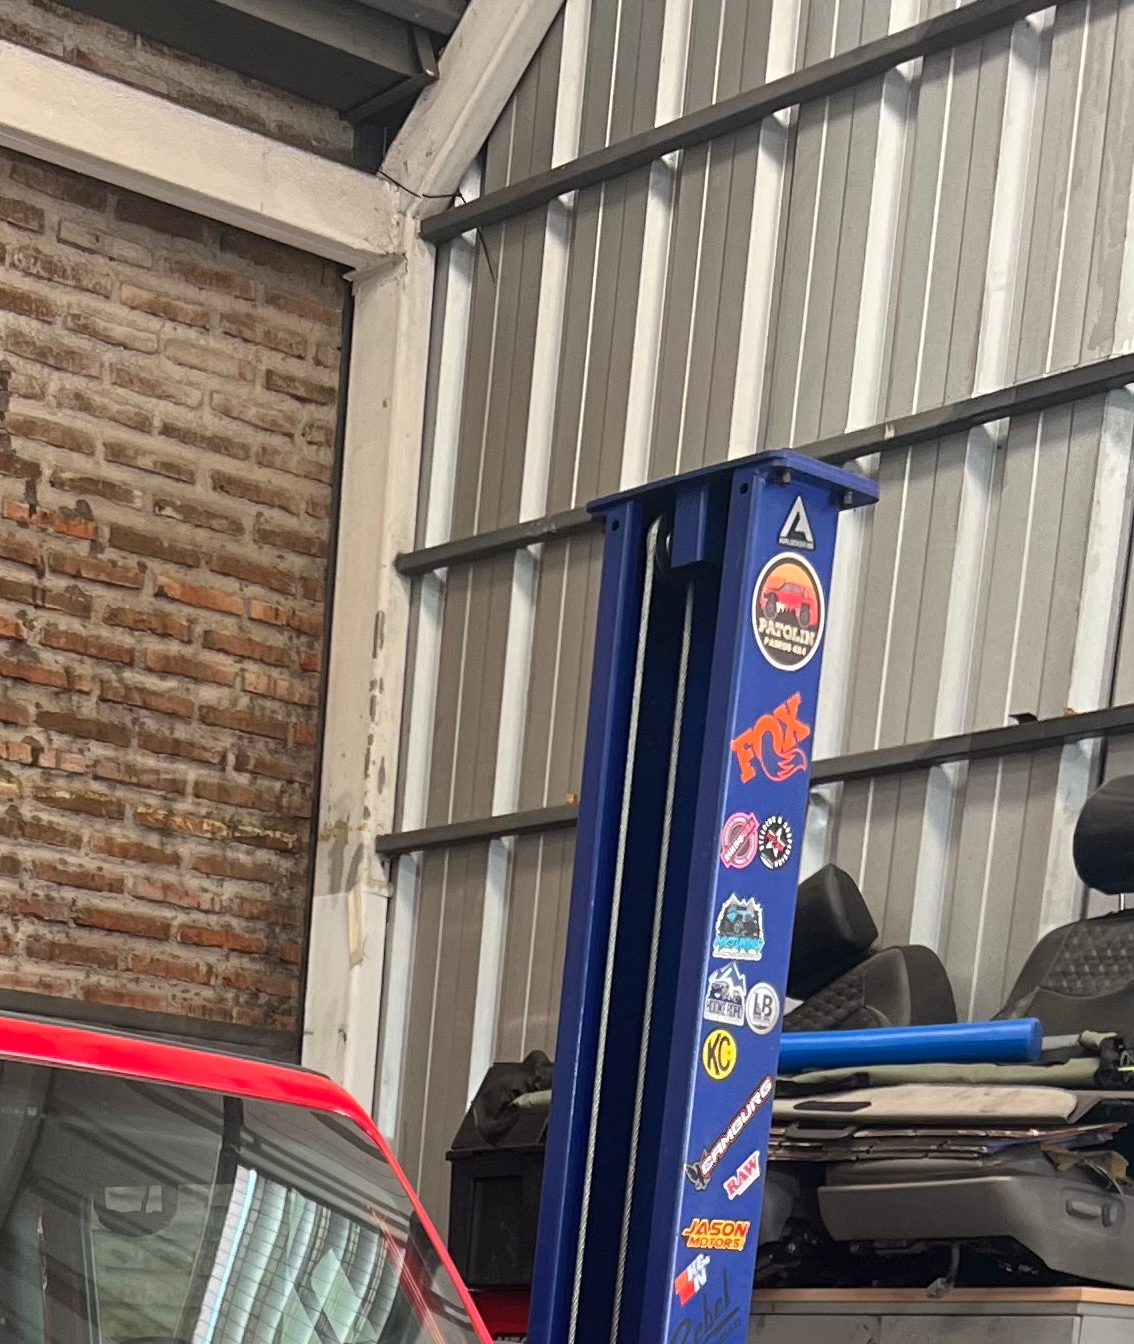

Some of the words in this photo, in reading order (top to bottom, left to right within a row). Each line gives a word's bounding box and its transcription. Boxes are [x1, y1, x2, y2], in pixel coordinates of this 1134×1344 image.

[758, 617, 815, 647] PATOLIN
[731, 692, 810, 783] FOX
[753, 991, 774, 1017] LB
[707, 1032, 732, 1076] KC
[701, 1077, 773, 1176] CAMBURG
[726, 1156, 760, 1196] RAW
[683, 1219, 750, 1238] JASON
[688, 1236, 744, 1250] MOTORS
